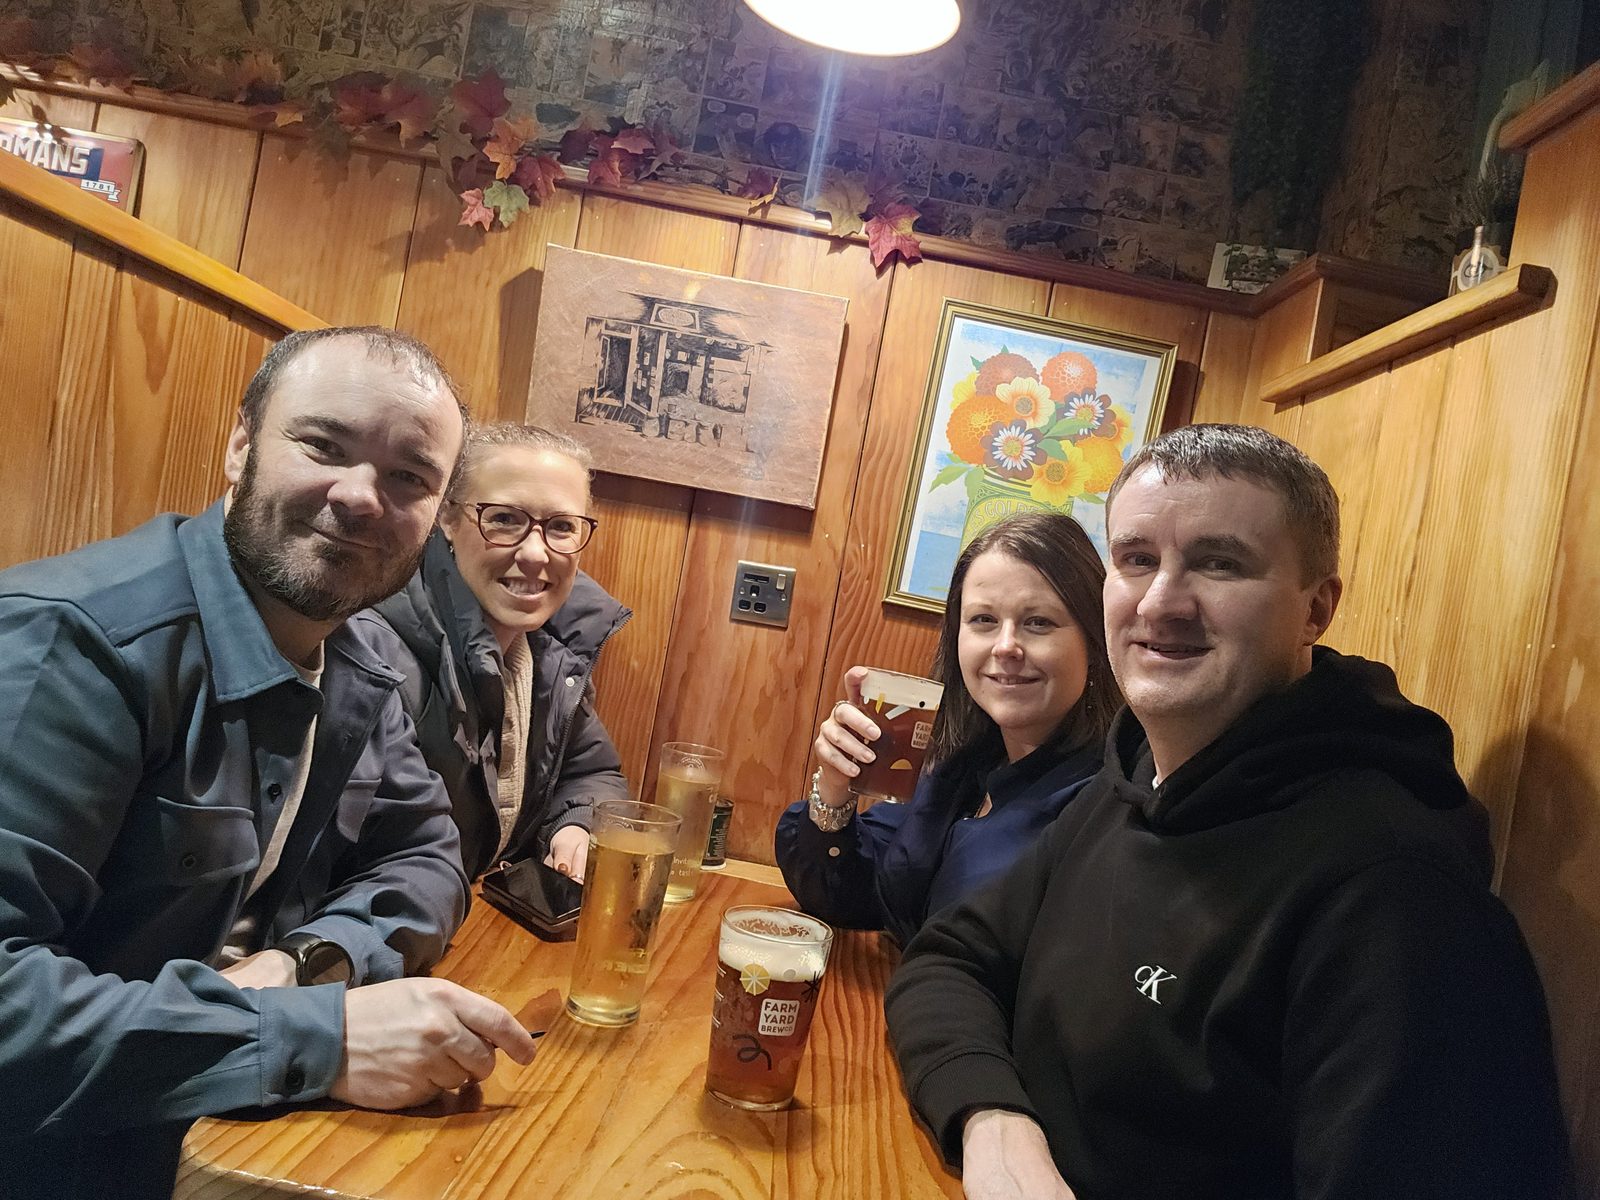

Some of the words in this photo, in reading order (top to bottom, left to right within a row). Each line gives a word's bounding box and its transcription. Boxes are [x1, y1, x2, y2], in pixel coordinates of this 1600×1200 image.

[1134, 965, 1178, 1005] CK
[764, 1001, 798, 1013] FARM
[763, 1012, 795, 1025] YARD
